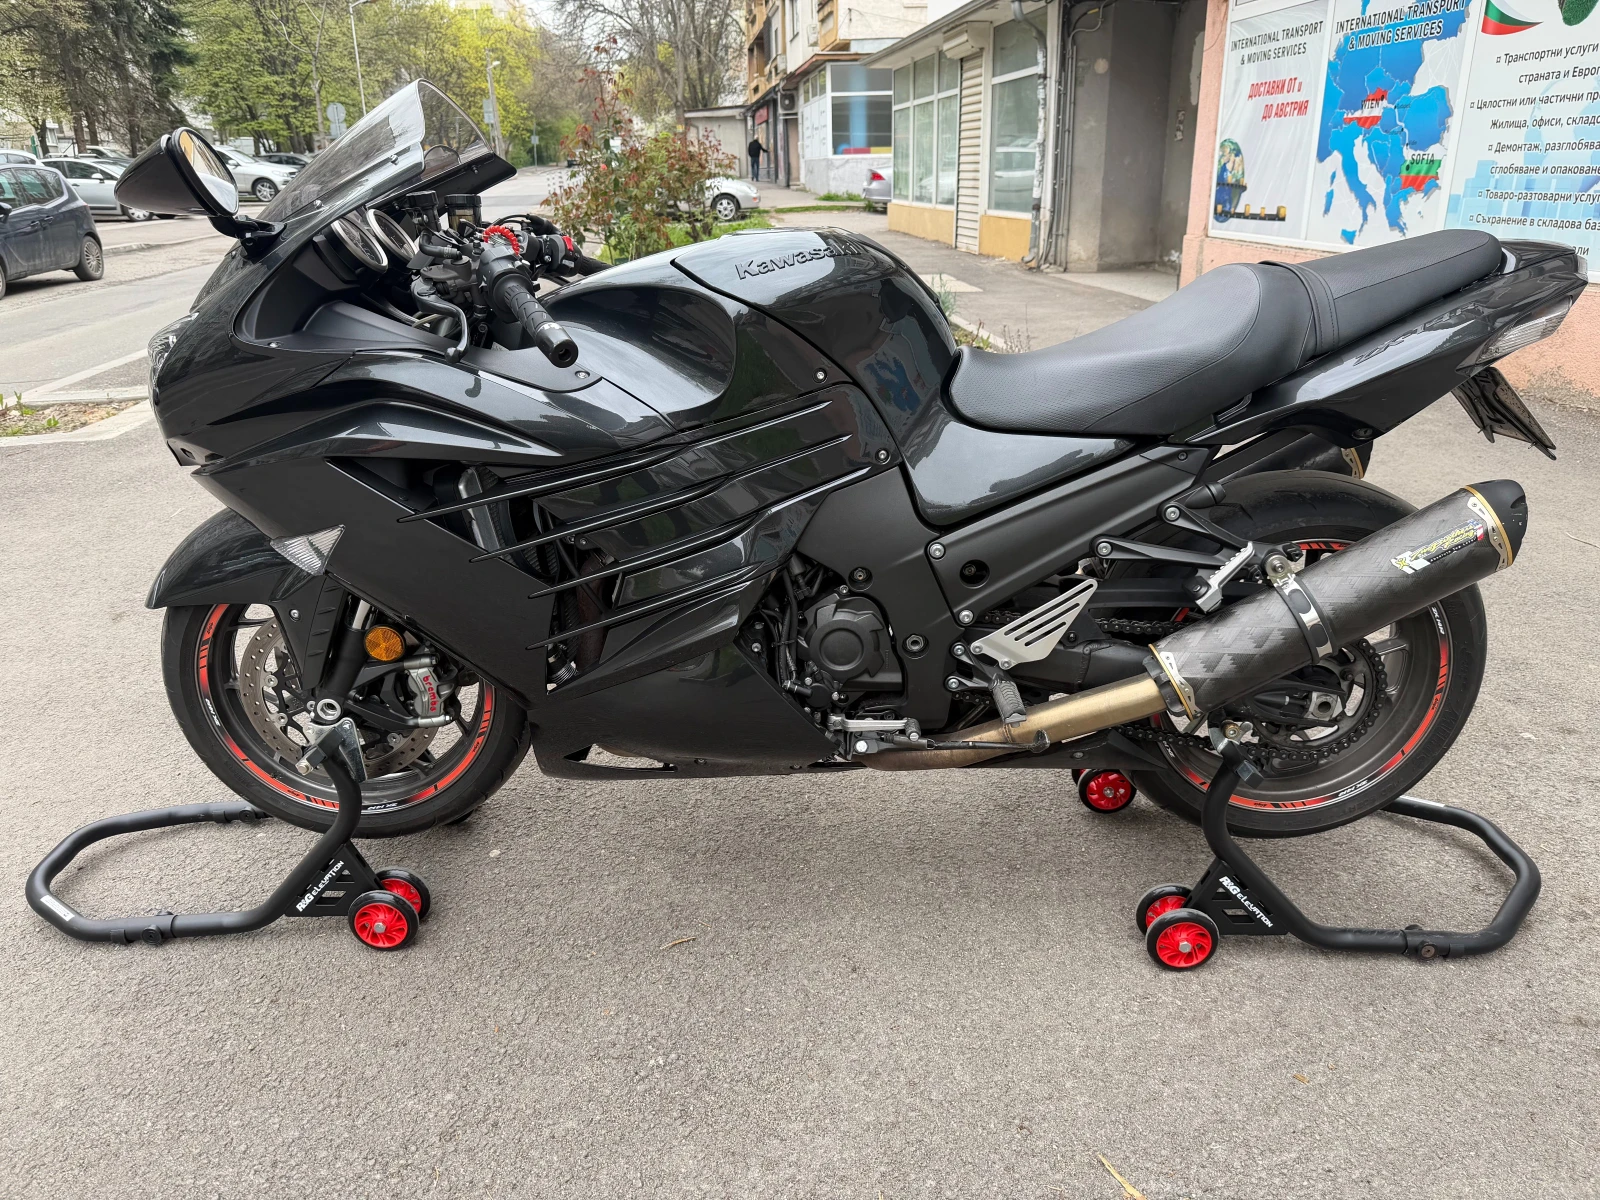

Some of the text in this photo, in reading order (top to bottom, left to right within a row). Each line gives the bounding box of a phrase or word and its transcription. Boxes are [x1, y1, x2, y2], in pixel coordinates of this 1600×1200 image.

[1335, 0, 1465, 34] INTERNATIONAL TRANSPORT
[1231, 21, 1324, 52] INTERNATIONAL TRANSPORT
[1348, 20, 1443, 50] & MOVING SERVICES
[1240, 42, 1307, 65] & MOVING SERVICES
[1504, 42, 1600, 66] Транспортни услуги
[1286, 77, 1298, 94] ОТ
[1518, 70, 1561, 85] страната
[1563, 69, 1570, 78] и
[1361, 100, 1380, 111] WIEN
[1476, 98, 1518, 110] Цялостни
[1519, 96, 1537, 107] или
[1538, 92, 1585, 105] частични
[1261, 100, 1309, 122] ДО АВСТРИЯ
[1490, 119, 1530, 129] Жилища,
[1531, 116, 1564, 130] офиси,
[1494, 142, 1542, 154] Демонтаж,
[1410, 153, 1435, 165] SOFIA
[1490, 163, 1540, 175] сглобяване
[1541, 166, 1548, 174] и
[1485, 189, 1572, 203] Товаро-разтоварни
[1475, 214, 1527, 226] Съхранение
[1536, 219, 1582, 230] складова
[735, 240, 861, 280] Kawasaki
[1219, 876, 1241, 895] R&G
[296, 893, 315, 912] R&G
